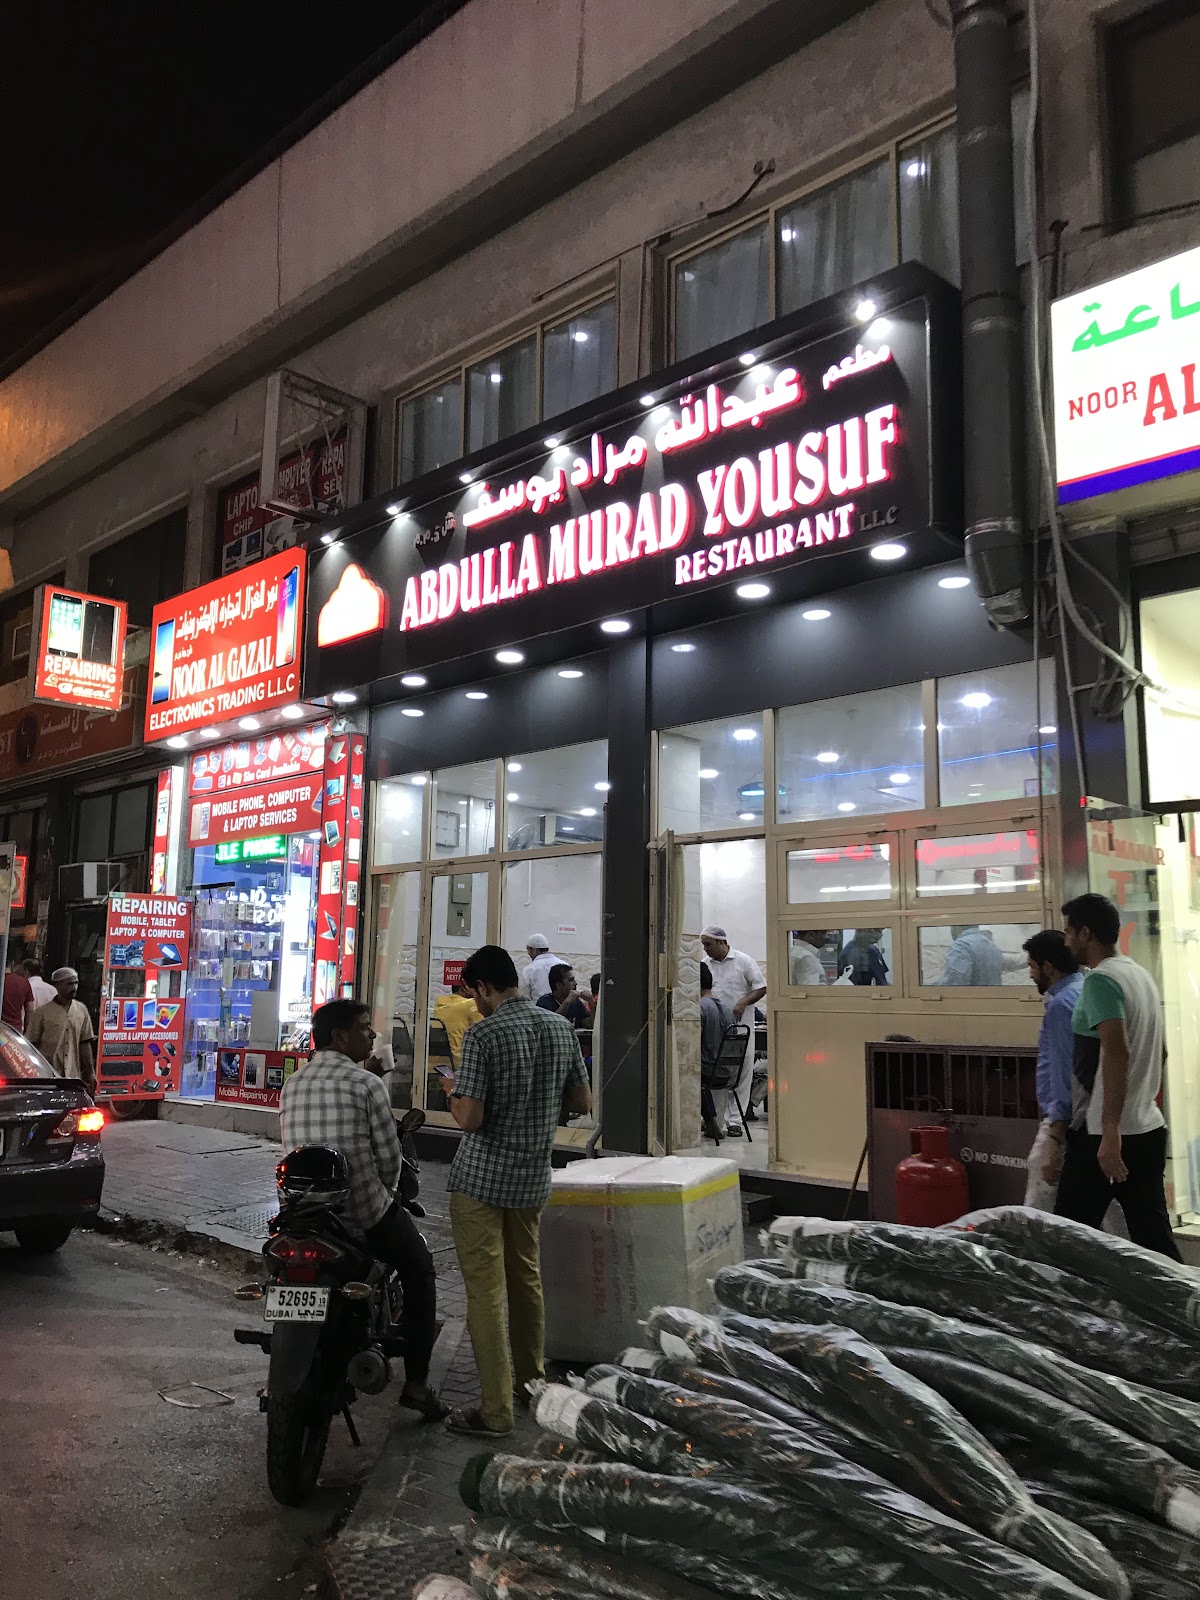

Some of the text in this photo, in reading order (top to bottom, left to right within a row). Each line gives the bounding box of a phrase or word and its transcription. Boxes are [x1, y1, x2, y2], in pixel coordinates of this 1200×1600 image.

[823, 344, 892, 390] مطعم
[1068, 381, 1138, 421] NOOR
[571, 433, 647, 485] مراد
[227, 486, 258, 521] LAPTO
[463, 466, 566, 527] يوسف
[233, 516, 254, 536] CHIP
[400, 403, 898, 633] ABDULLA MURAD YOUSUF
[674, 502, 855, 586] RESTAURANT
[44, 654, 117, 684] REPAIRING
[172, 635, 275, 700] NOOR AL GAZAL
[150, 673, 295, 731] ELECTRONICS TRADING L.L.C
[212, 787, 311, 817] MOBILE PHONE, COMPUTER
[223, 808, 297, 832] & LAPTOP SERVICES
[111, 898, 187, 916] REPAIRING
[121, 916, 176, 927] MOBILE, TABLET
[110, 927, 185, 938] LAPTOP & COMPUTER
[103, 1032, 127, 1040] COMPUTER
[132, 1032, 149, 1040] LAPTOP
[218, 1087, 238, 1098] Mobile
[239, 1089, 268, 1102] Repairing
[975, 1151, 1027, 1168] NO SMOKIN
[278, 1290, 317, 1307] 52695
[266, 1310, 293, 1318] DUBAI
